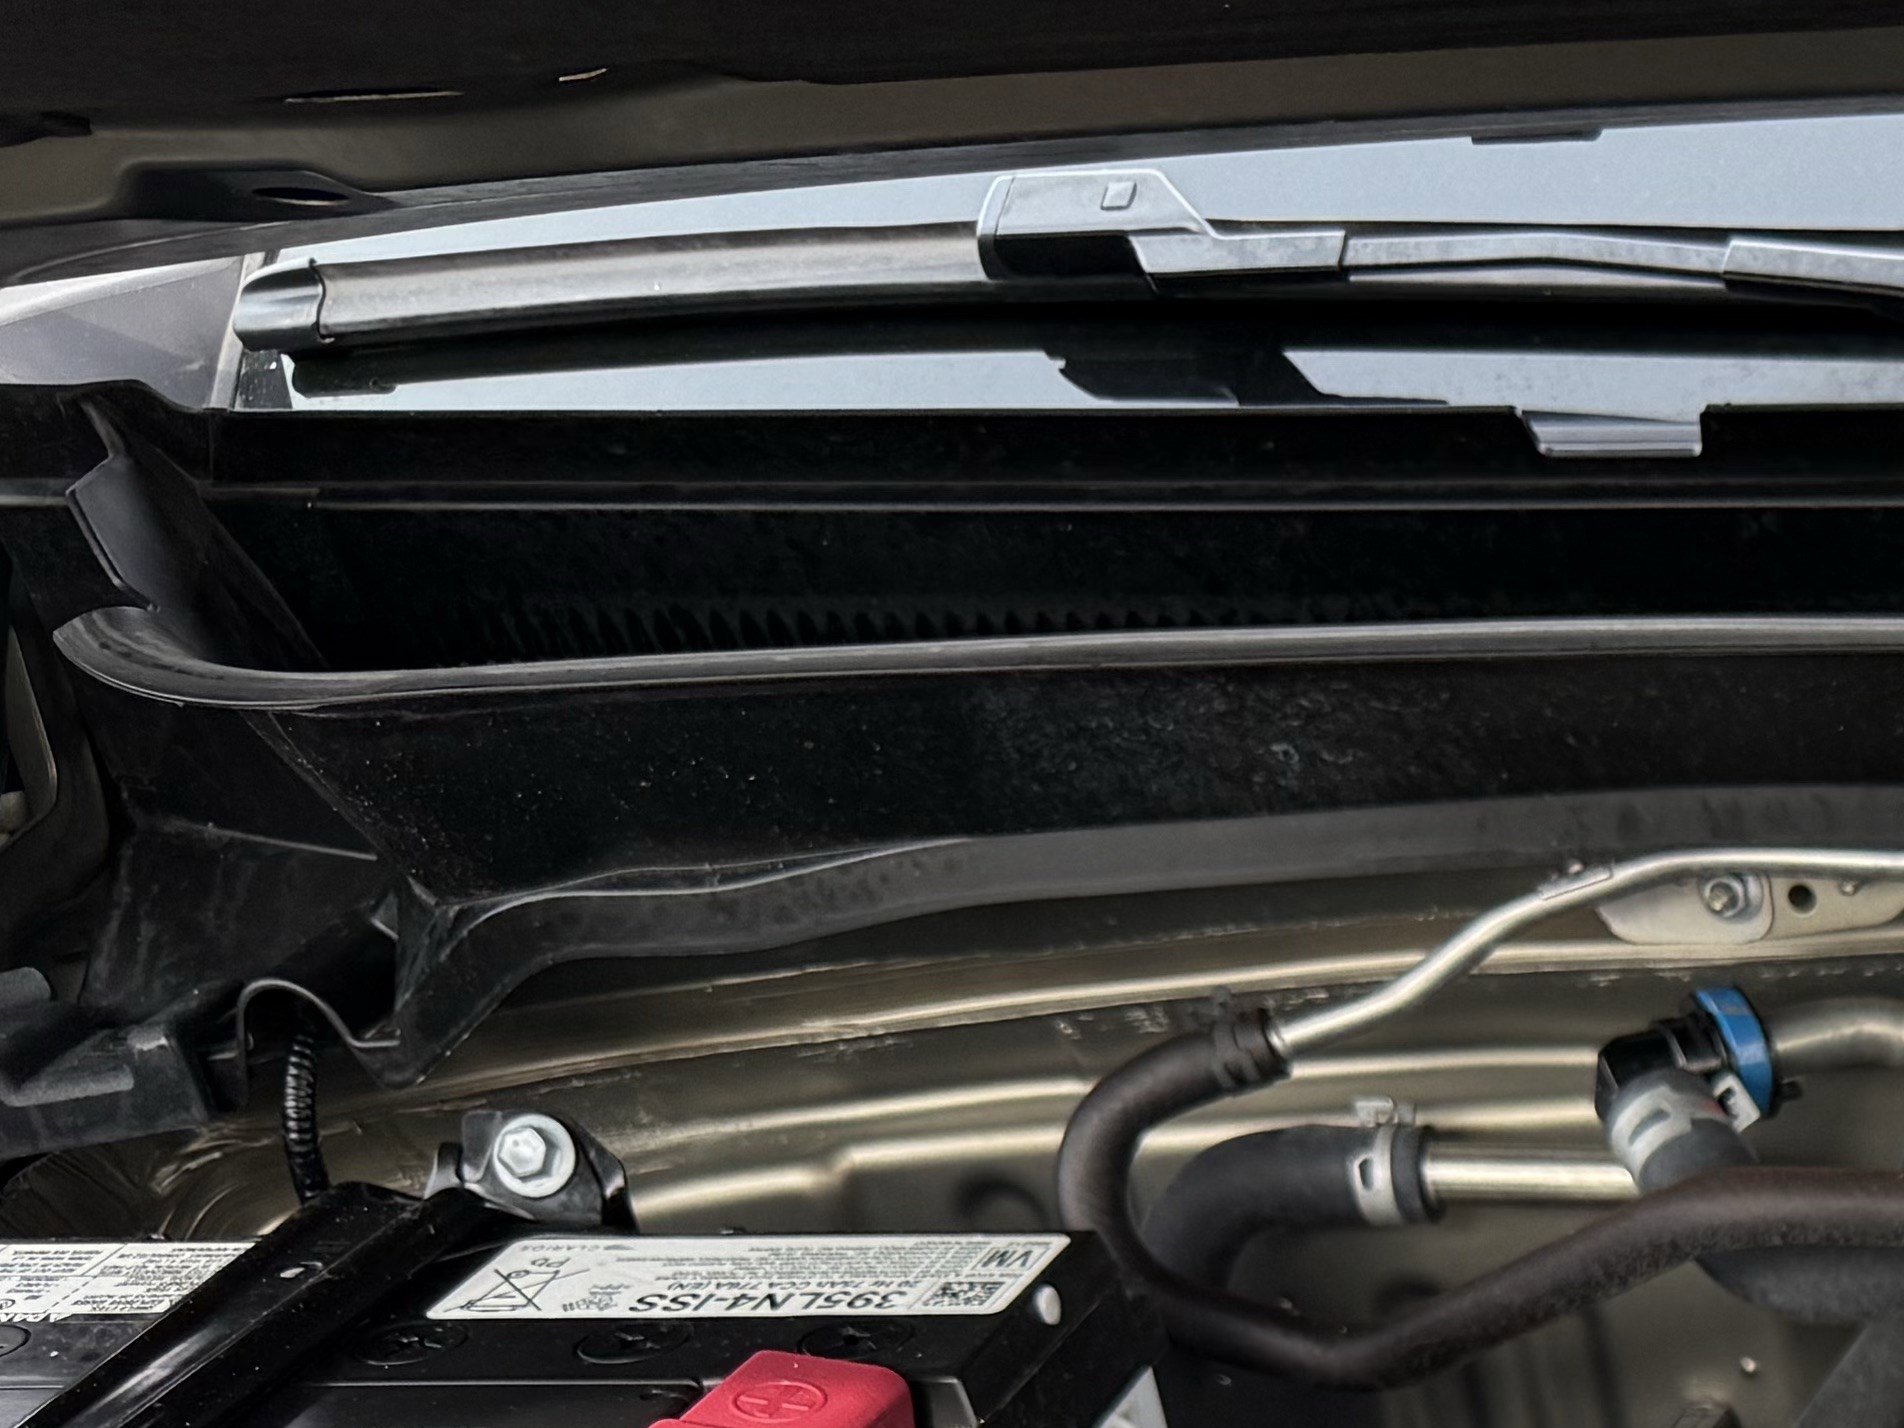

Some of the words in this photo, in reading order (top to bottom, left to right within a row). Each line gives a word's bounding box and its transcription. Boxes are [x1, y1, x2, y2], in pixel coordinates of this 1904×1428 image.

[530, 1257, 571, 1268] Pb
[981, 1249, 1034, 1268] VM
[629, 1290, 907, 1312] 395LN4-ISS
